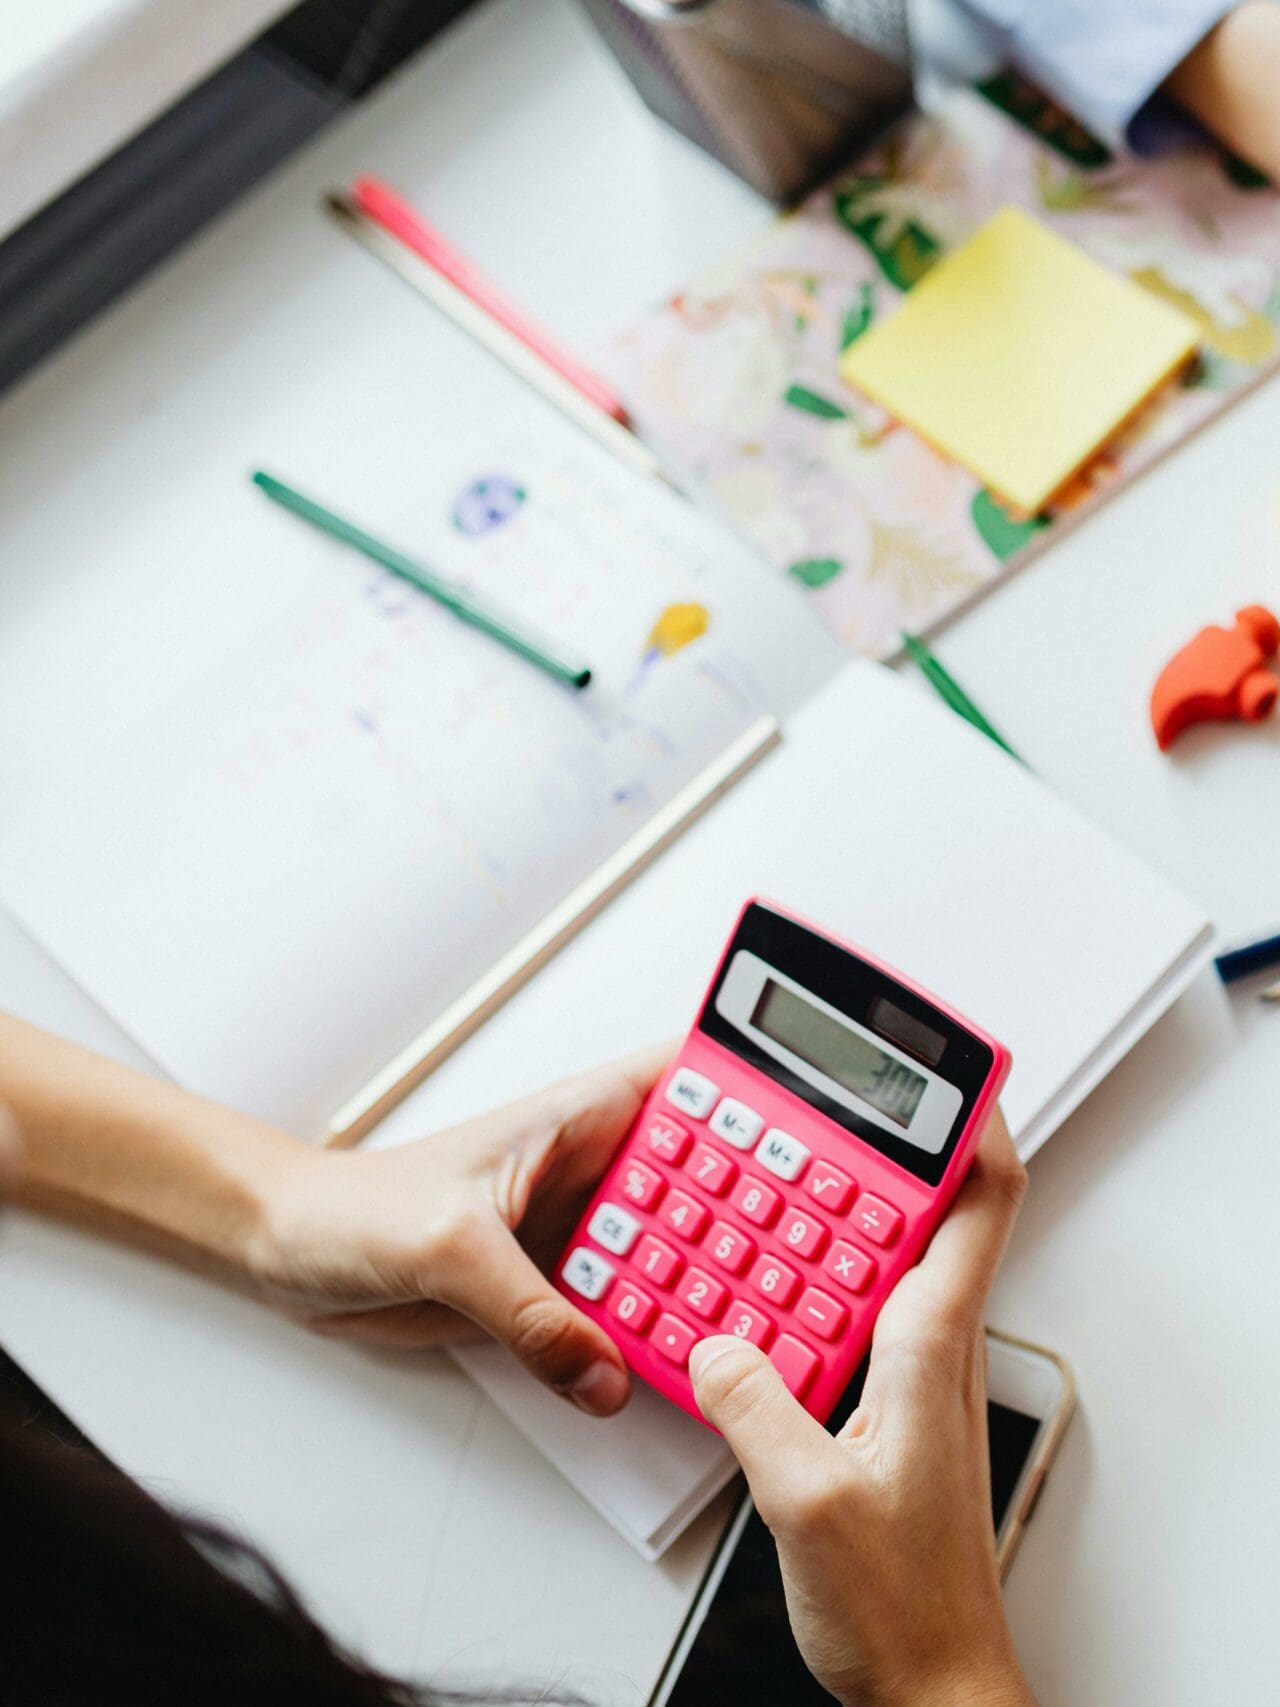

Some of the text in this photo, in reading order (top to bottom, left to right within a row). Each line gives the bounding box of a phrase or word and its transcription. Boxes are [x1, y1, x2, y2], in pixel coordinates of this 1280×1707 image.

[676, 1082, 703, 1107] MRC
[722, 1113, 746, 1134] M-
[767, 1141, 792, 1164] M+
[697, 1156, 718, 1180] 7
[741, 1188, 762, 1213] 8
[787, 1220, 807, 1245] 9
[602, 1217, 753, 1338] CE 1 2 3
[670, 1205, 688, 1228] 4
[714, 1234, 736, 1259] 5
[760, 1268, 780, 1292] 6
[617, 1294, 637, 1320] 0
